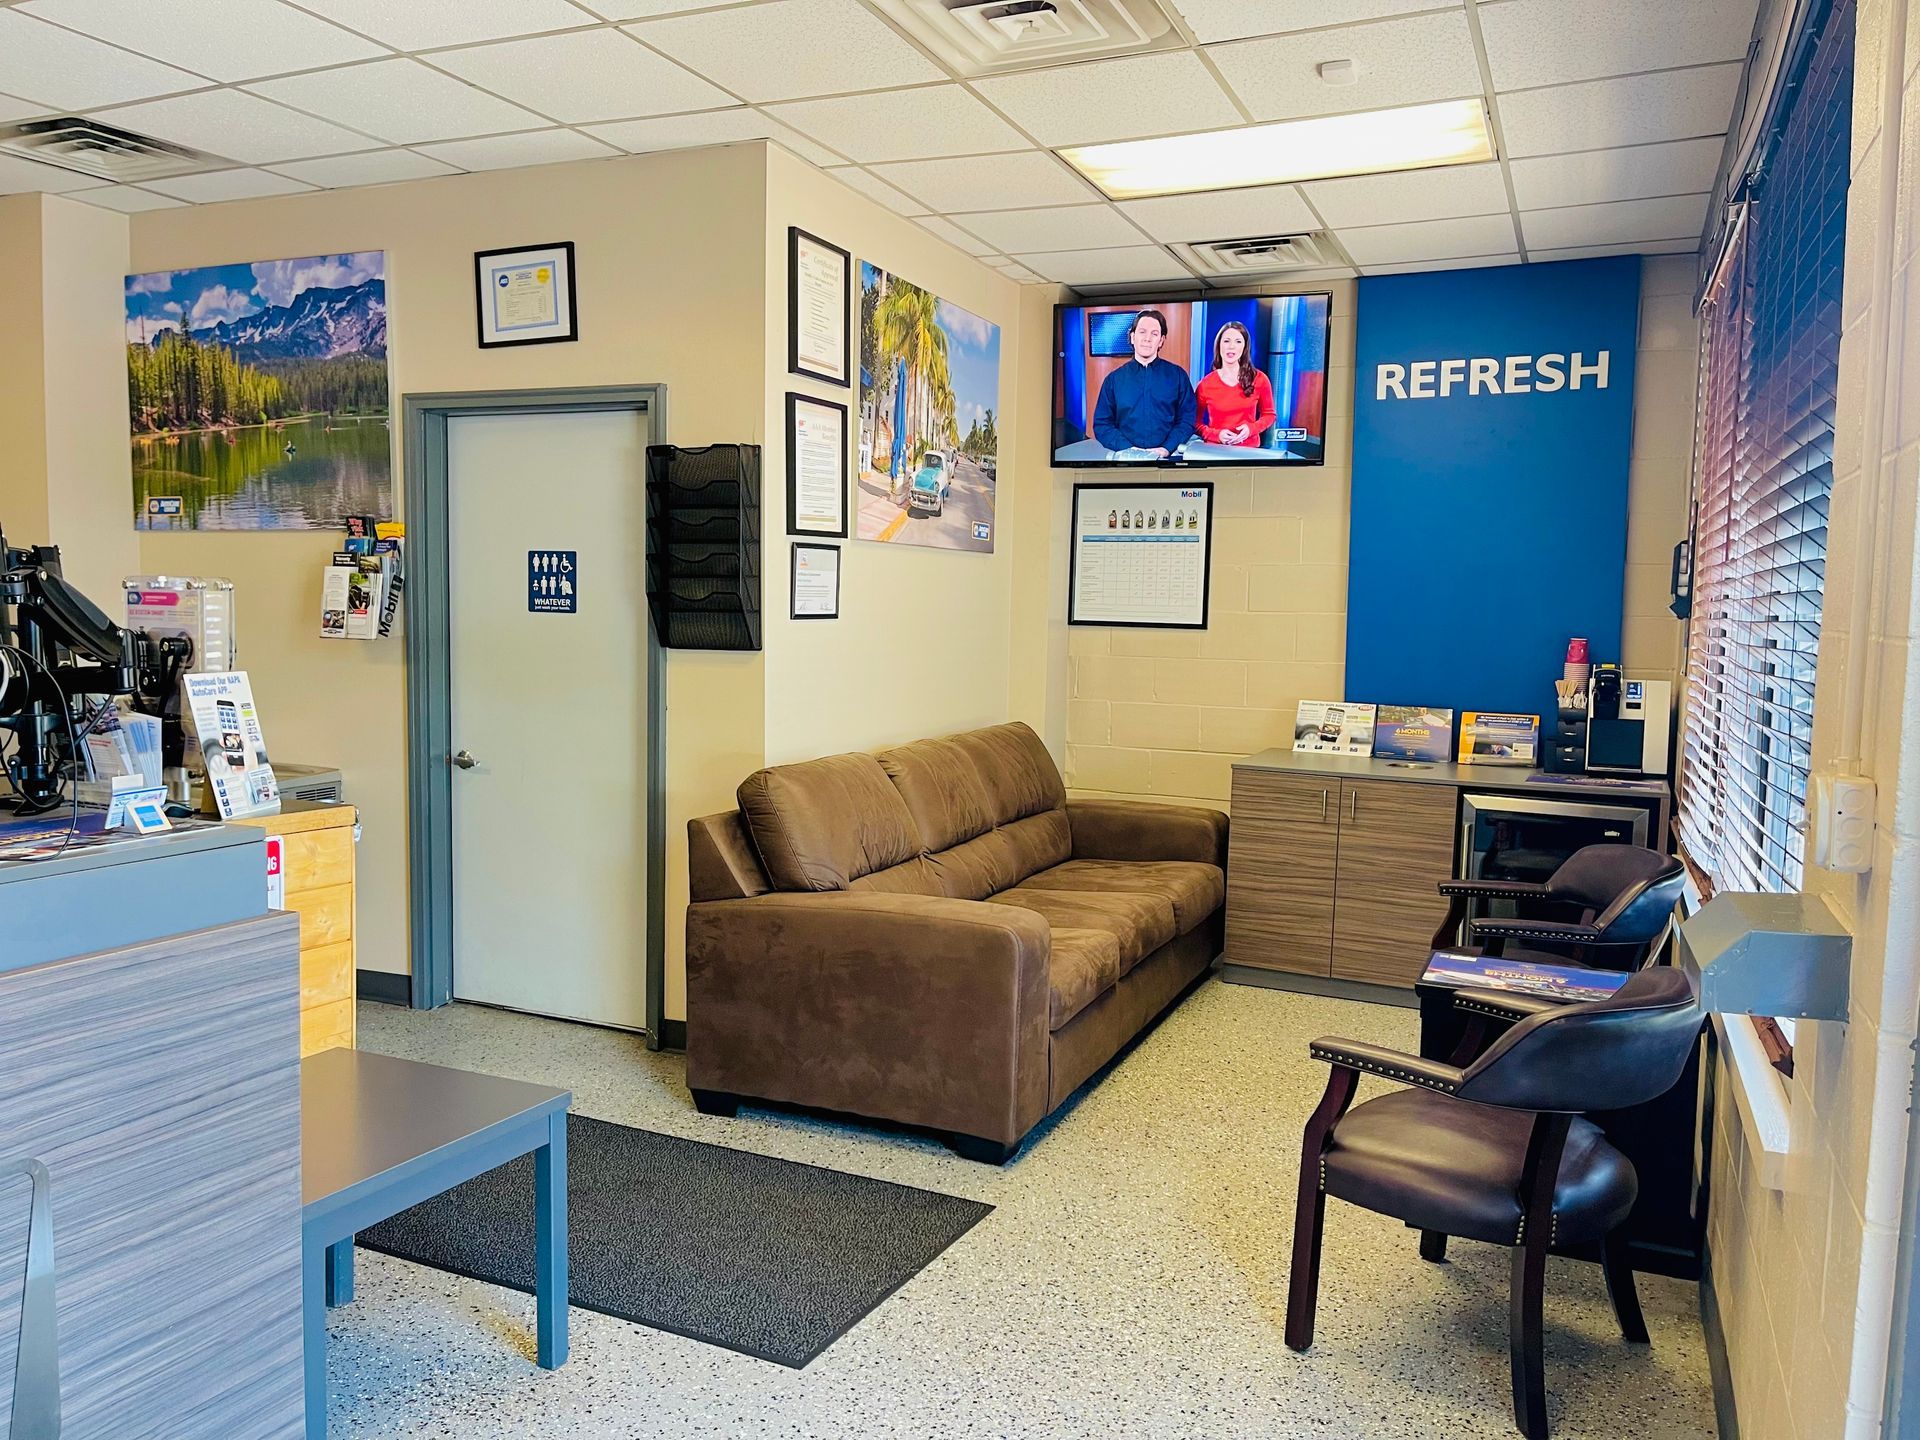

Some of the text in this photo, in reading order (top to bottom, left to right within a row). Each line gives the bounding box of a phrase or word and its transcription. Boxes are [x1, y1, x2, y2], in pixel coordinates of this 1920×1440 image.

[1376, 350, 1610, 400] REFRESH
[1181, 490, 1202, 498] Mobil
[534, 598, 571, 606] WHATEVER
[377, 591, 399, 638] Mobil
[189, 675, 241, 687] Download Our NAPA
[192, 687, 217, 697] AutoCare
[1401, 728, 1430, 736] MONTHS
